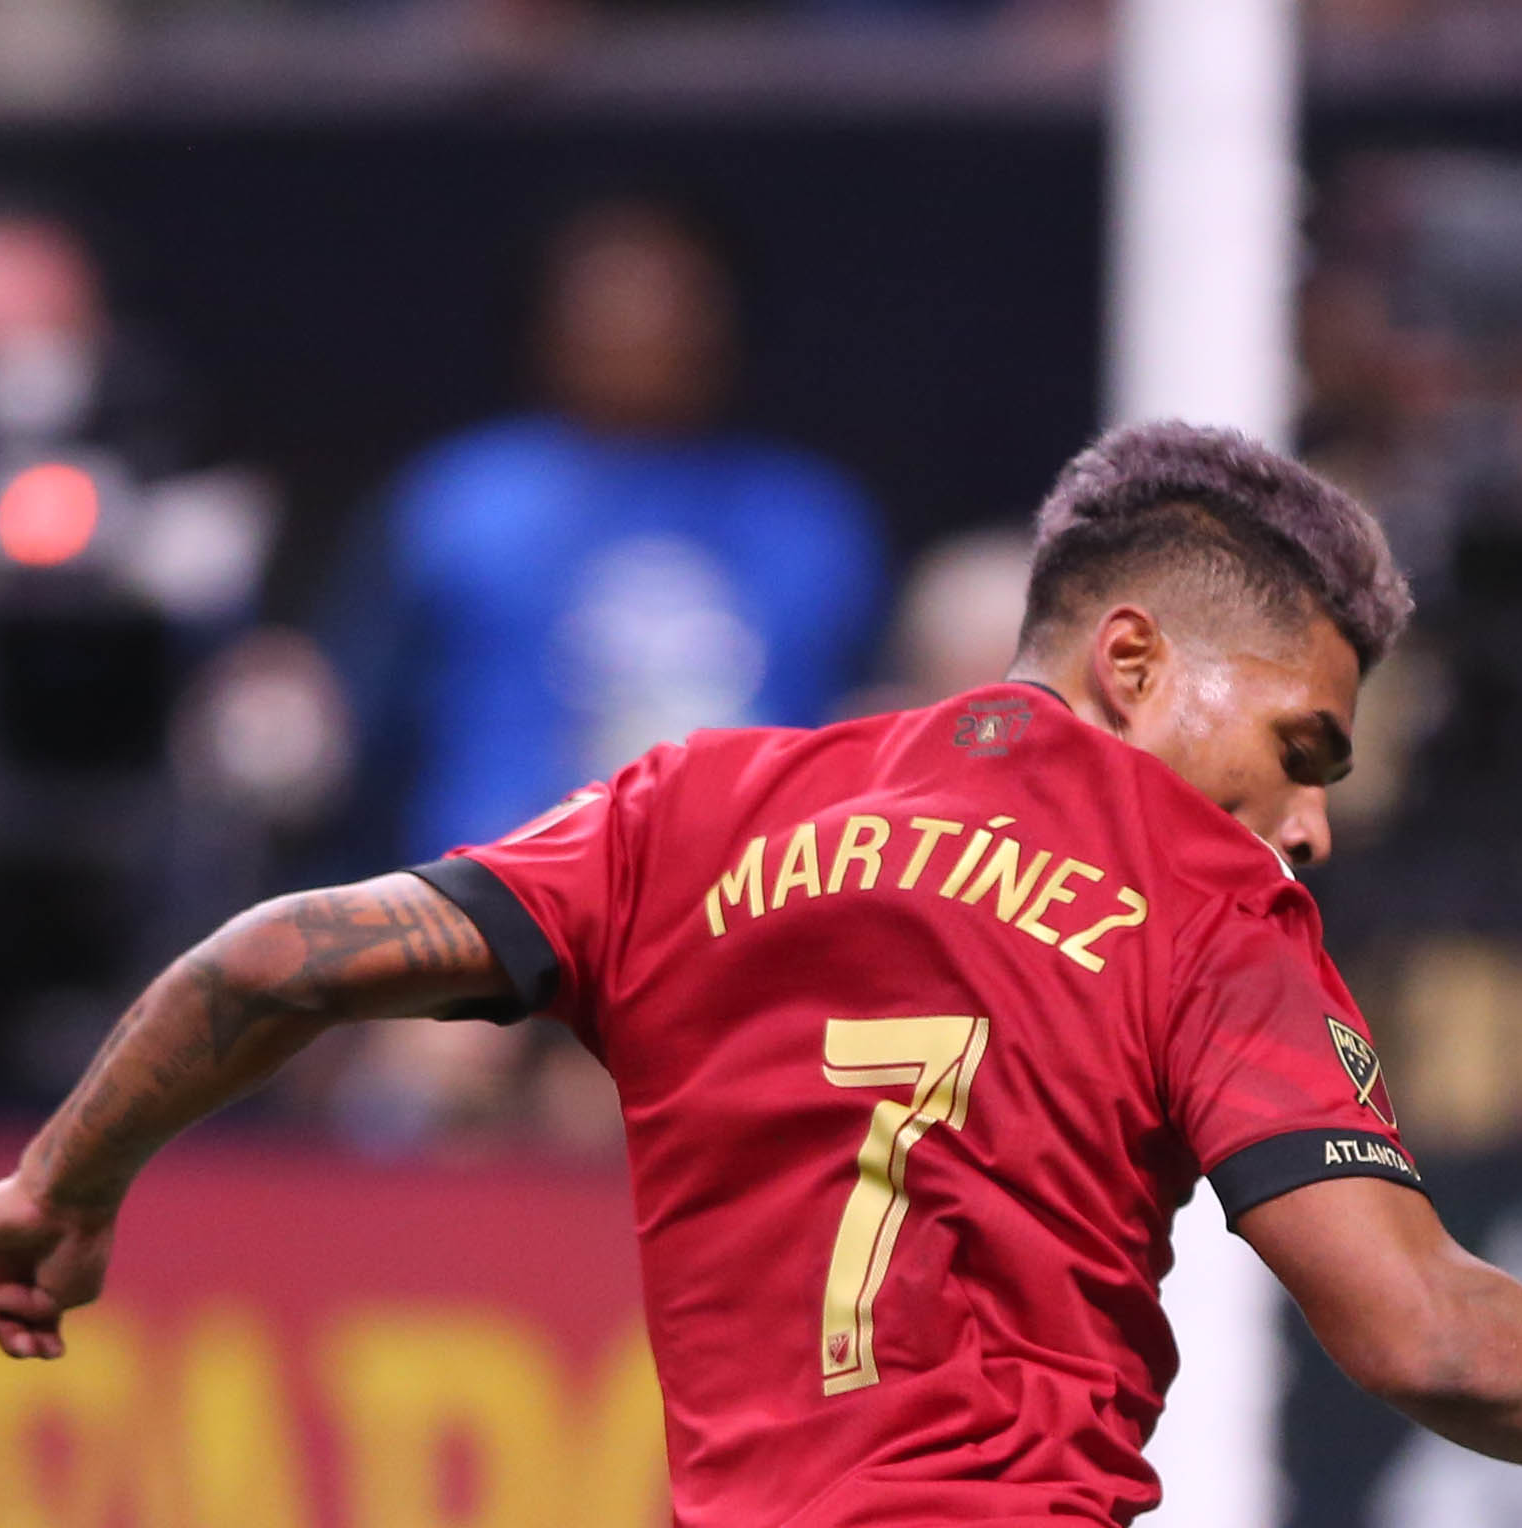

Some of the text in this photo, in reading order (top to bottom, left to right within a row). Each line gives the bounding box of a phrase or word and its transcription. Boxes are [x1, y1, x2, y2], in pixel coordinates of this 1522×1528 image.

[705, 815, 1148, 974] MARTÍNEZ
[1335, 1027, 1372, 1065] MLS
[823, 1016, 990, 1396] 7
[1325, 1139, 1413, 1176] ATLANTA
